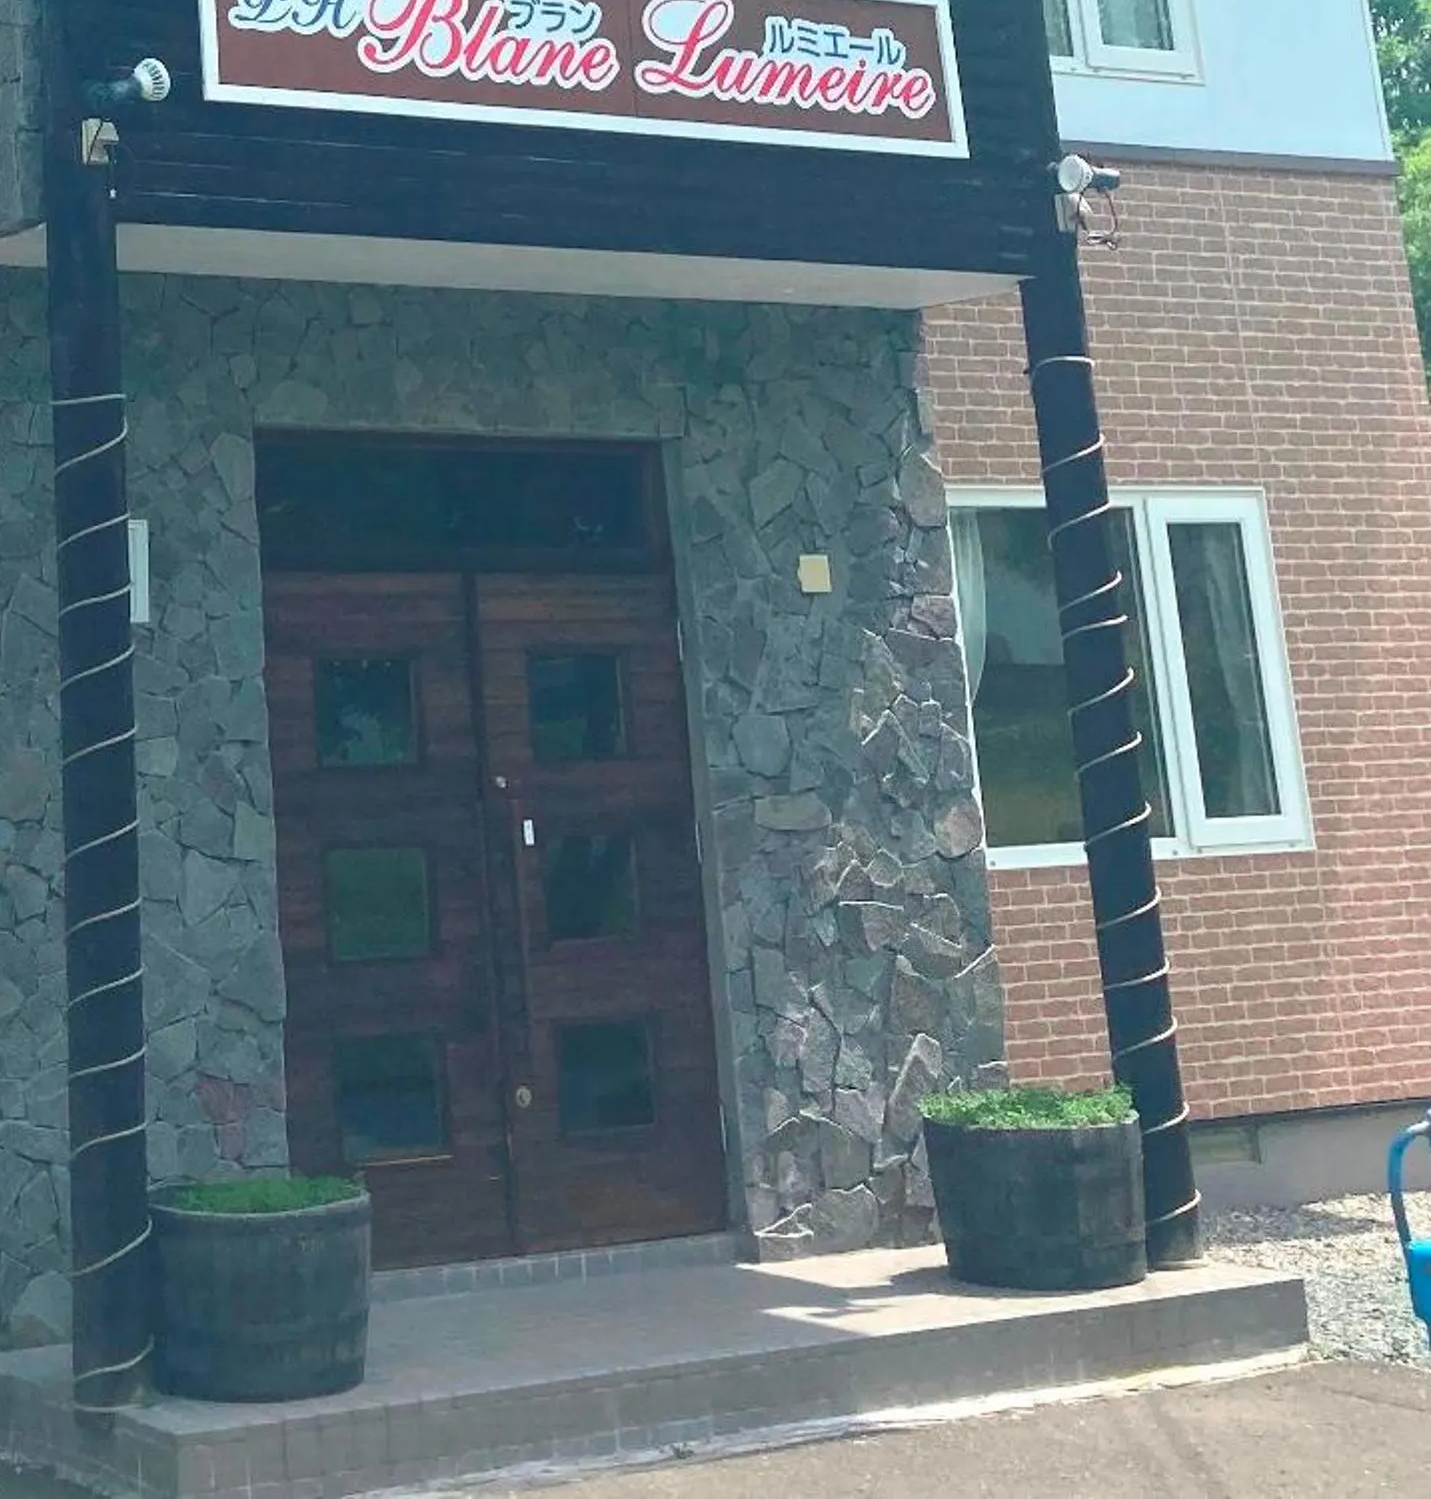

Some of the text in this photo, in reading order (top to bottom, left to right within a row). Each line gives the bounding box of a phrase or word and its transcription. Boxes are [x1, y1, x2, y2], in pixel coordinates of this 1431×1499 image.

[769, 23, 903, 65] ルミエール
